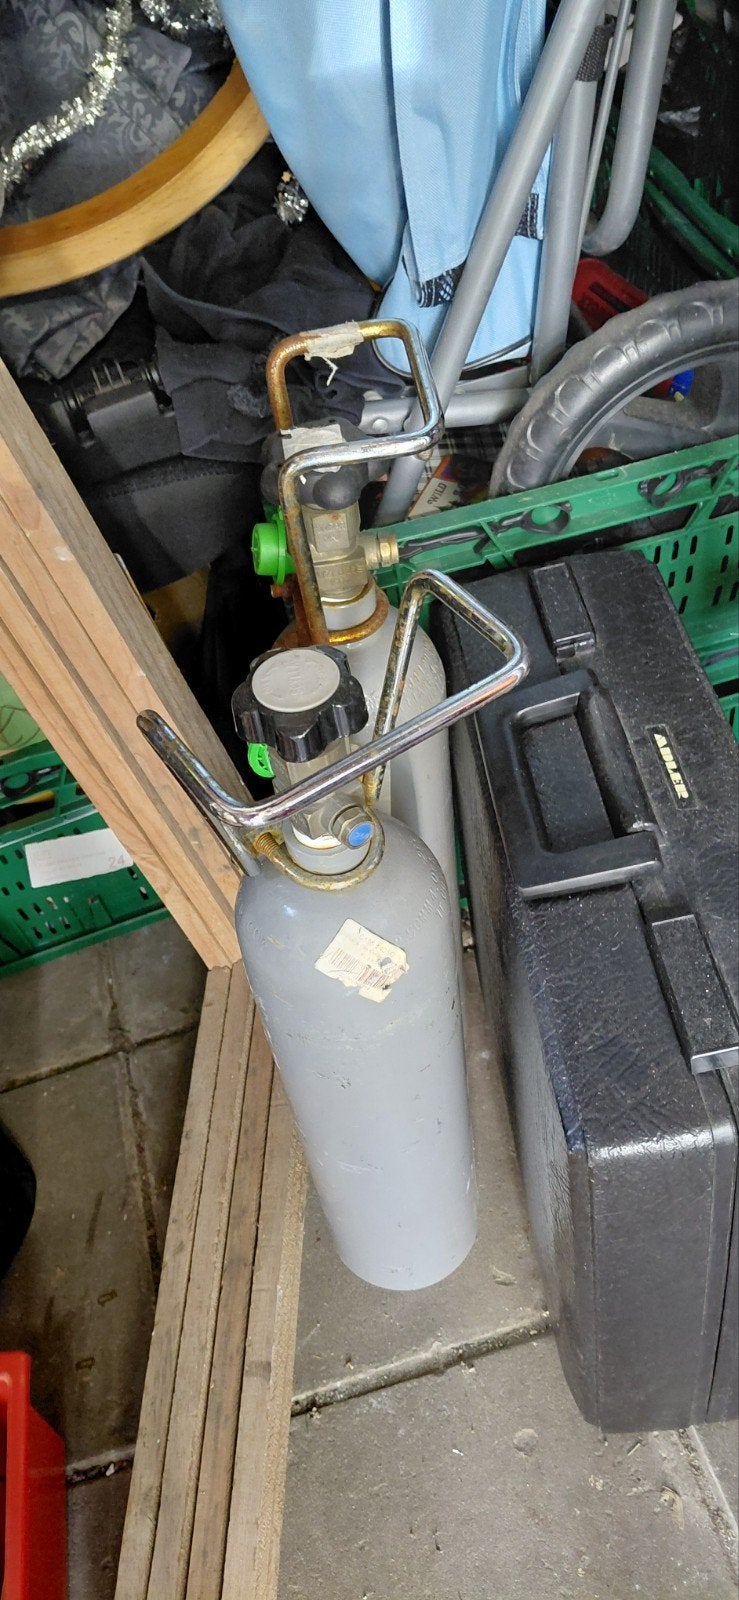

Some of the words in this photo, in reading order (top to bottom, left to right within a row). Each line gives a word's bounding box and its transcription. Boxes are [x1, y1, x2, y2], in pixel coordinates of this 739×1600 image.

[427, 482, 447, 505] WILD
[653, 733, 689, 799] ADLER
[107, 854, 125, 869] 24
